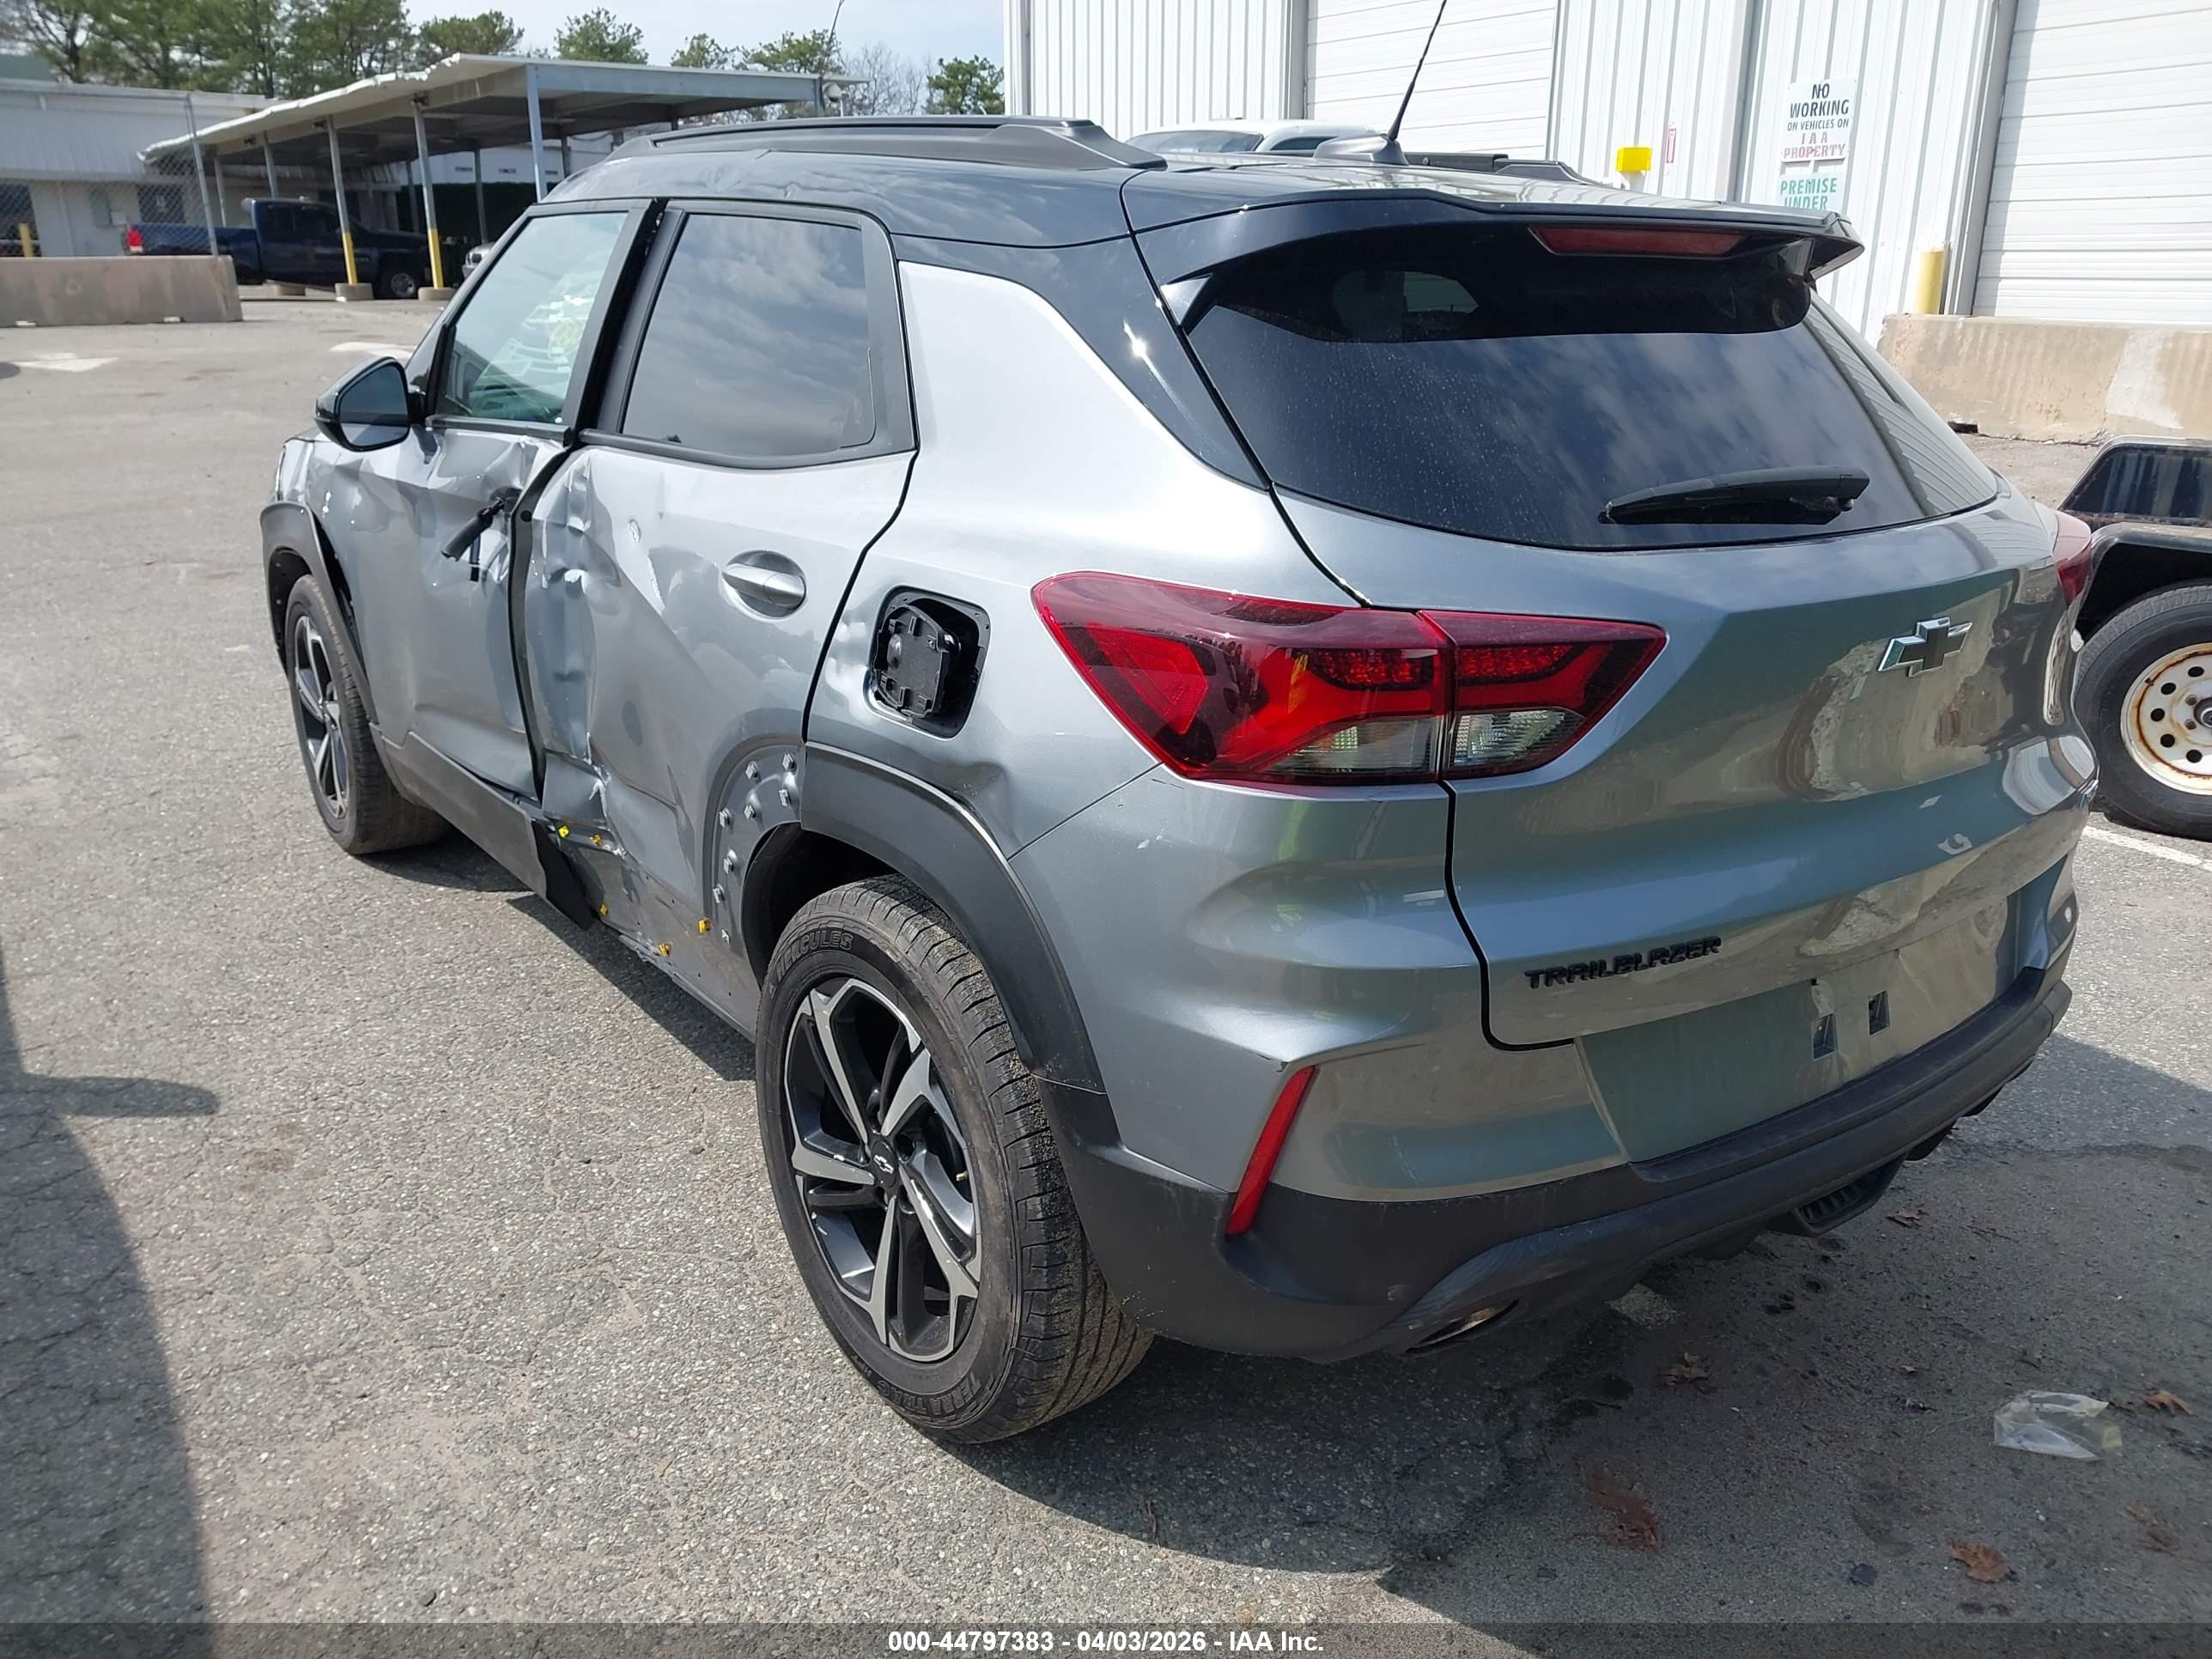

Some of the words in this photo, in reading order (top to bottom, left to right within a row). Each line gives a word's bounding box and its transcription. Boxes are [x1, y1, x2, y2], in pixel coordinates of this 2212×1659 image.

[1811, 83, 1830, 100] NO
[1790, 99, 1850, 118] WORKING
[1787, 122, 1798, 131] ON
[1800, 118, 1835, 131] VEHICLES
[1838, 118, 1850, 129] ON
[1784, 143, 1846, 159] PROPERTY
[1780, 178, 1838, 195] PREMISE
[1784, 196, 1828, 210] UNDER
[1524, 935, 1722, 989] TRAILBLAZER
